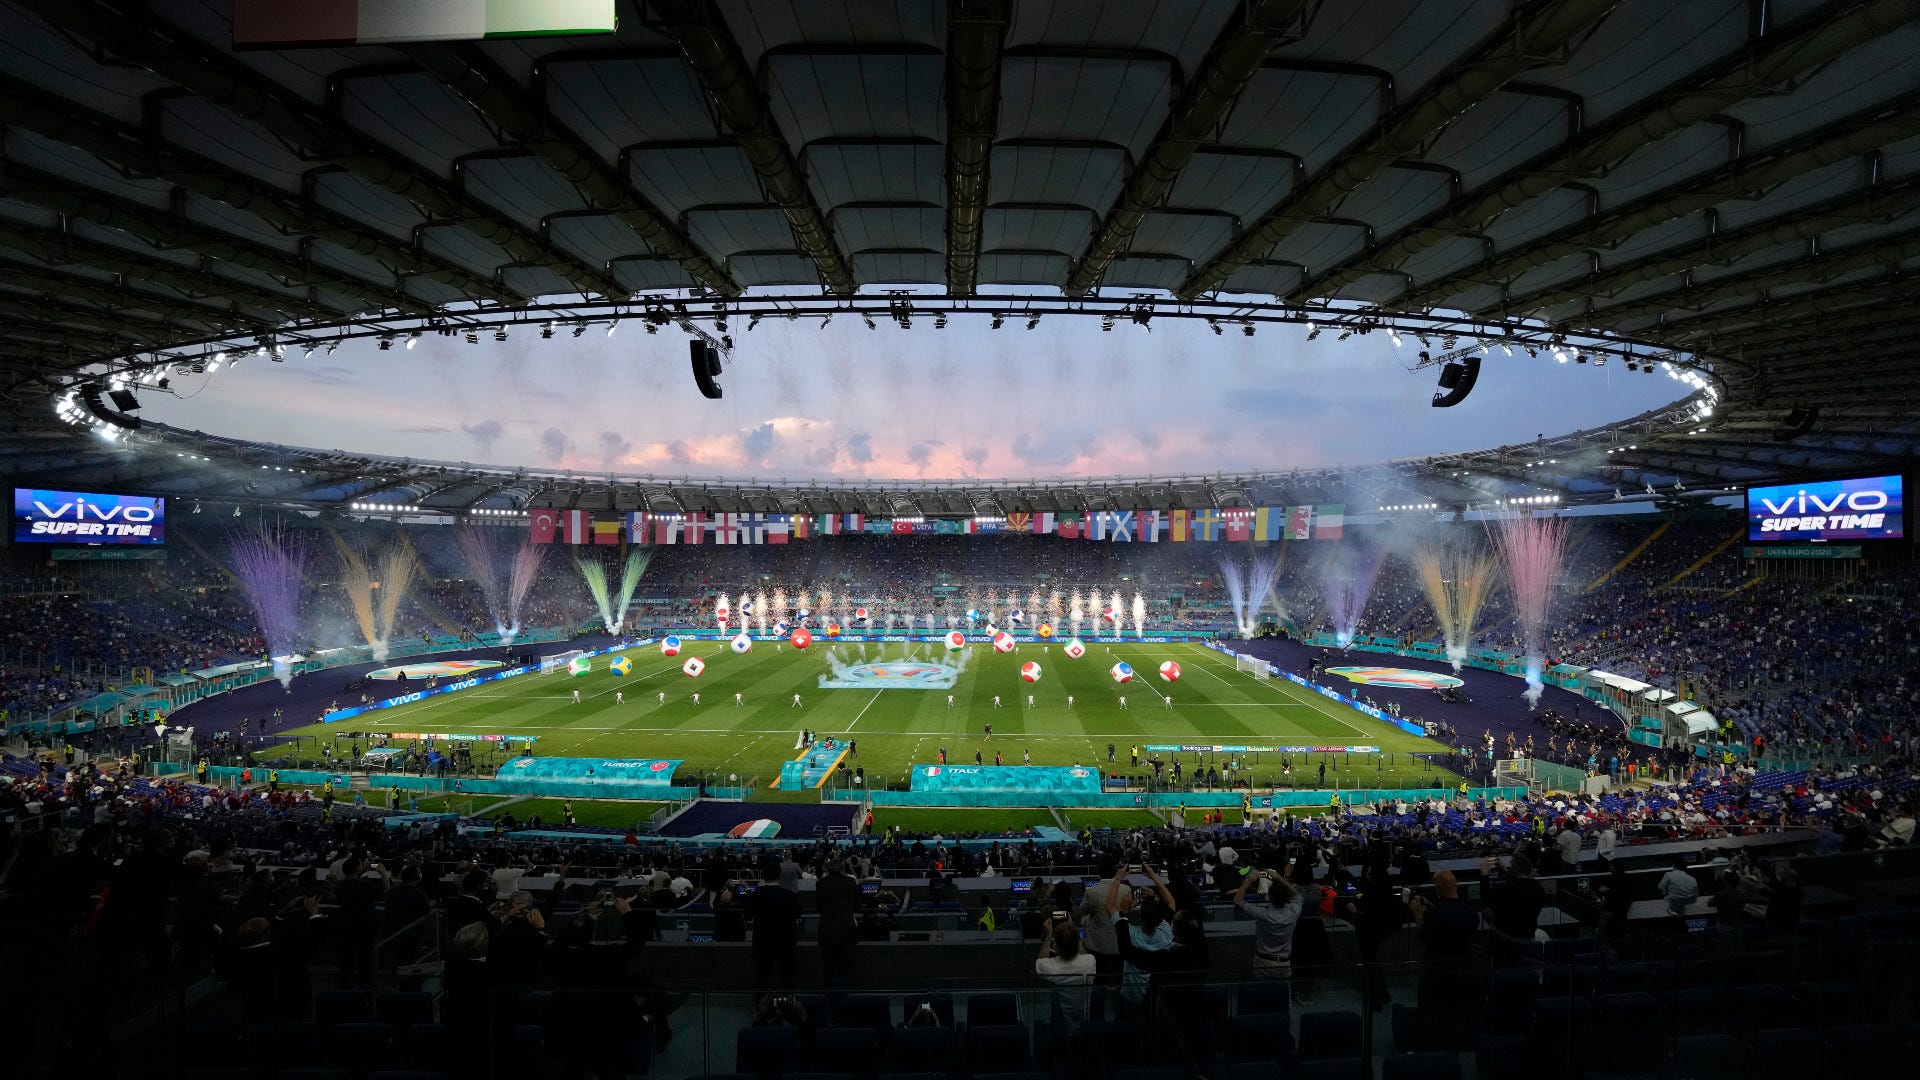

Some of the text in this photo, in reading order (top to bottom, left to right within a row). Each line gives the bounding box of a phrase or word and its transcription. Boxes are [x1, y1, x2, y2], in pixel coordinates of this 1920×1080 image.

[31, 521, 153, 537] SUPER TIME
[982, 522, 998, 530] FIFA
[1760, 513, 1886, 532] SUPER TIME
